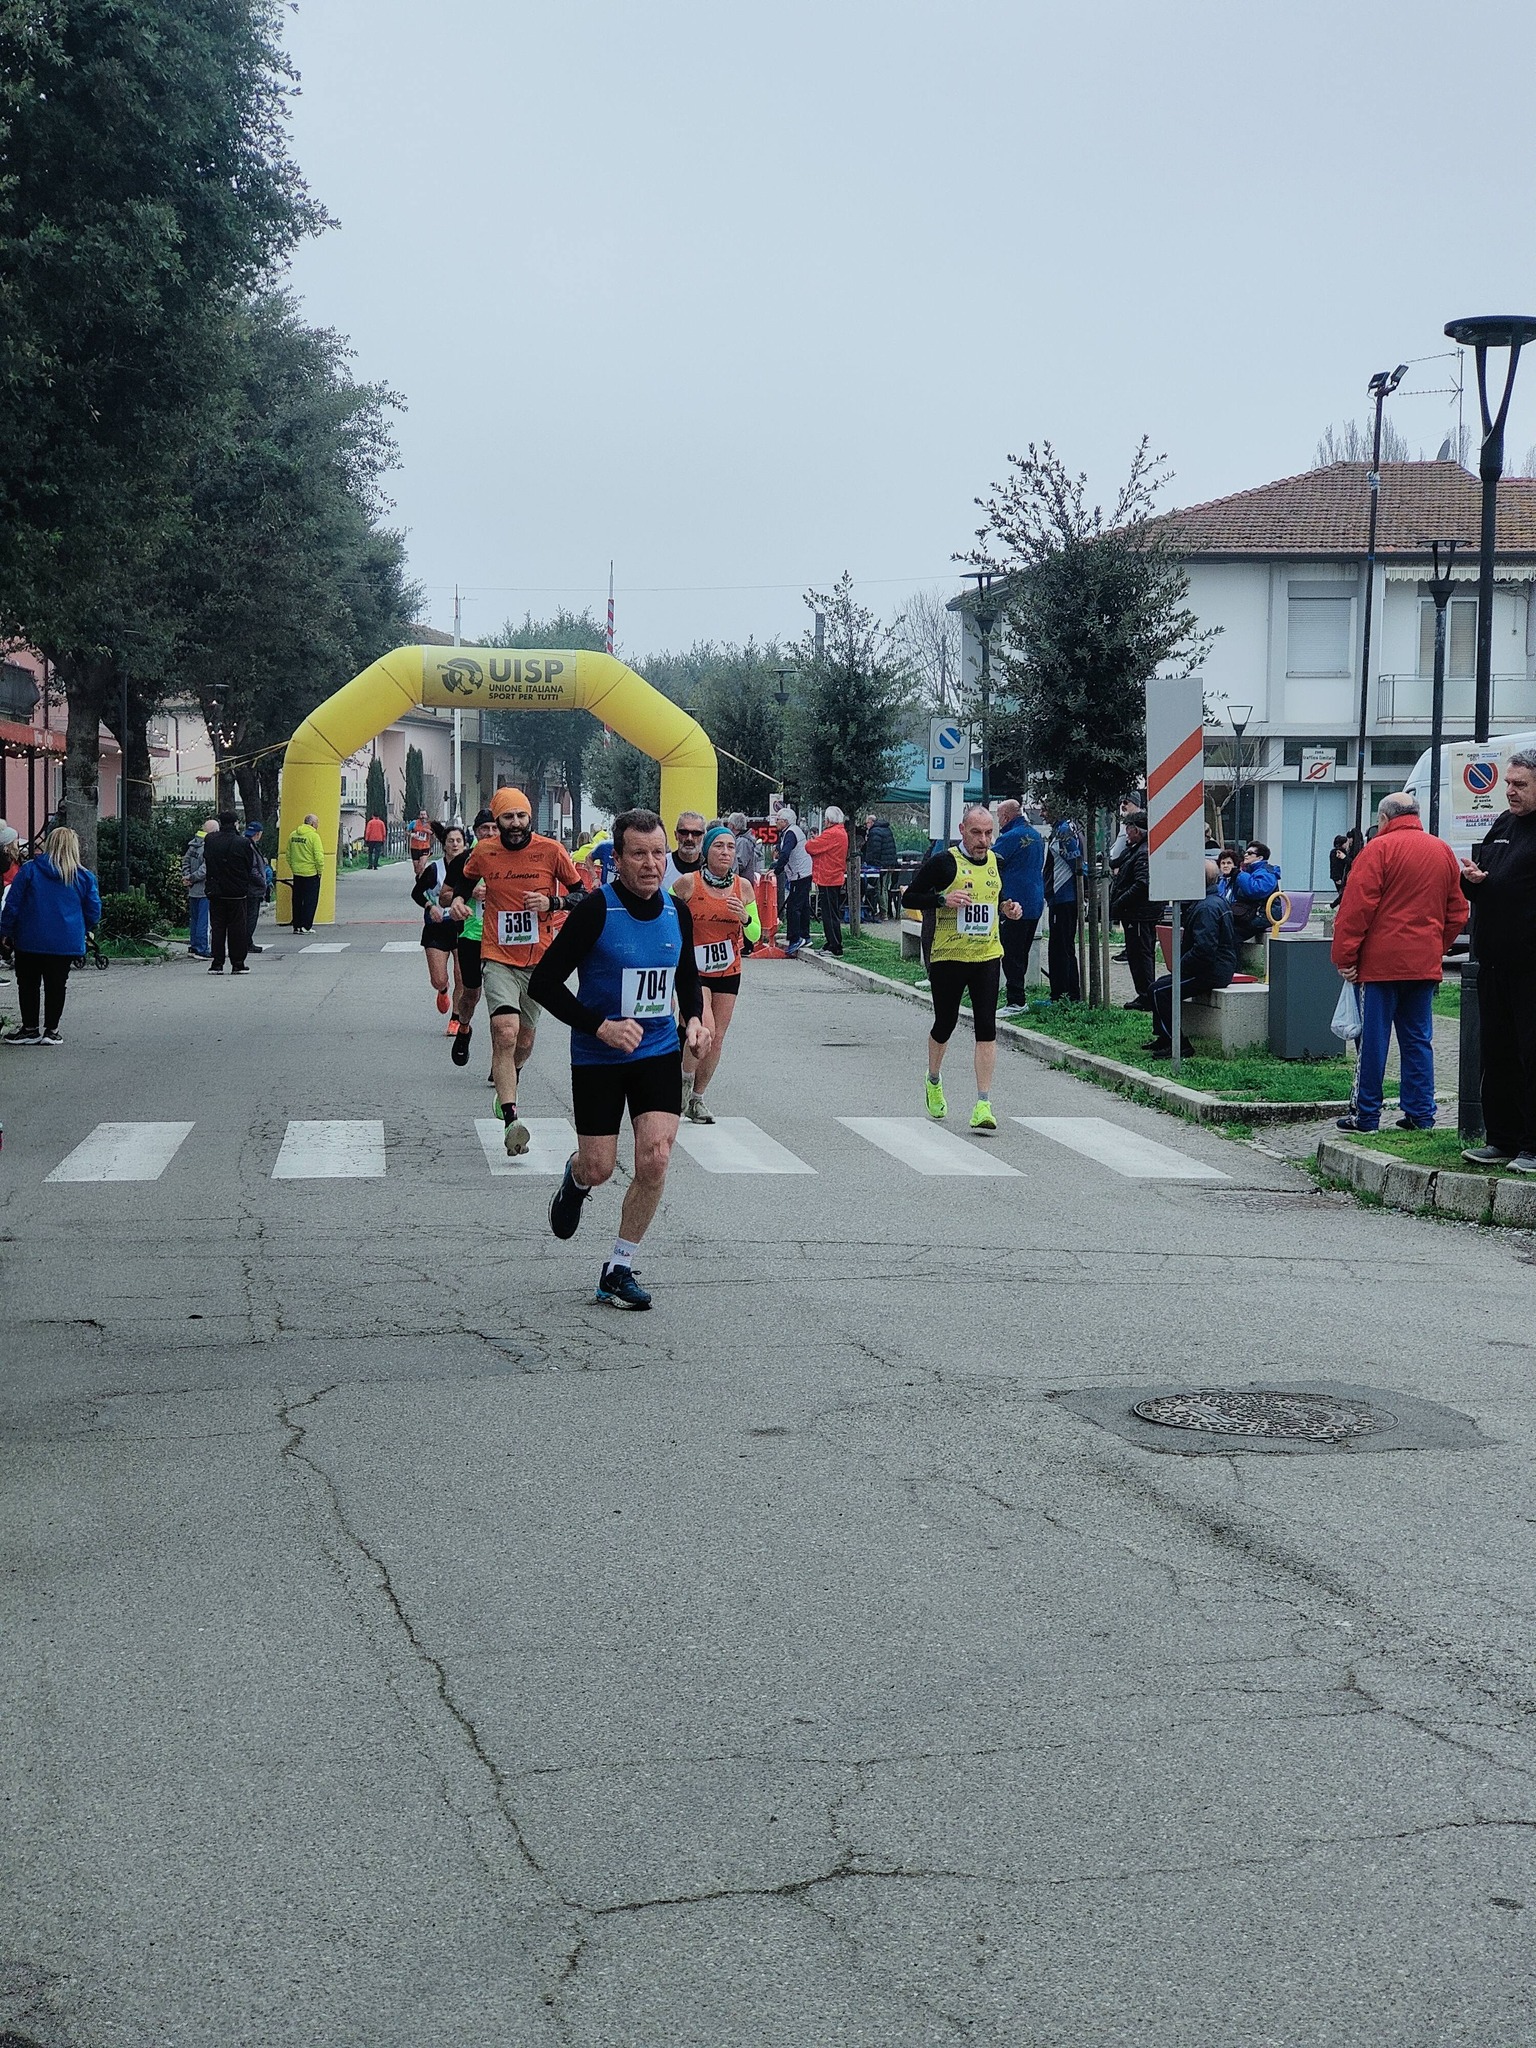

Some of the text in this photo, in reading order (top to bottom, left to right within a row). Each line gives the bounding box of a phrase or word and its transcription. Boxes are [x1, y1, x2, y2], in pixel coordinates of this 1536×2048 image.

[489, 658, 564, 684] UISP
[488, 684, 564, 694] UNIONE ITALIANA
[488, 692, 559, 701] SPORT PER TUTTI
[503, 870, 540, 880] Lamone
[505, 911, 532, 933] 536
[964, 904, 989, 923] 686
[702, 942, 728, 964] 789
[636, 970, 668, 1001] 704
